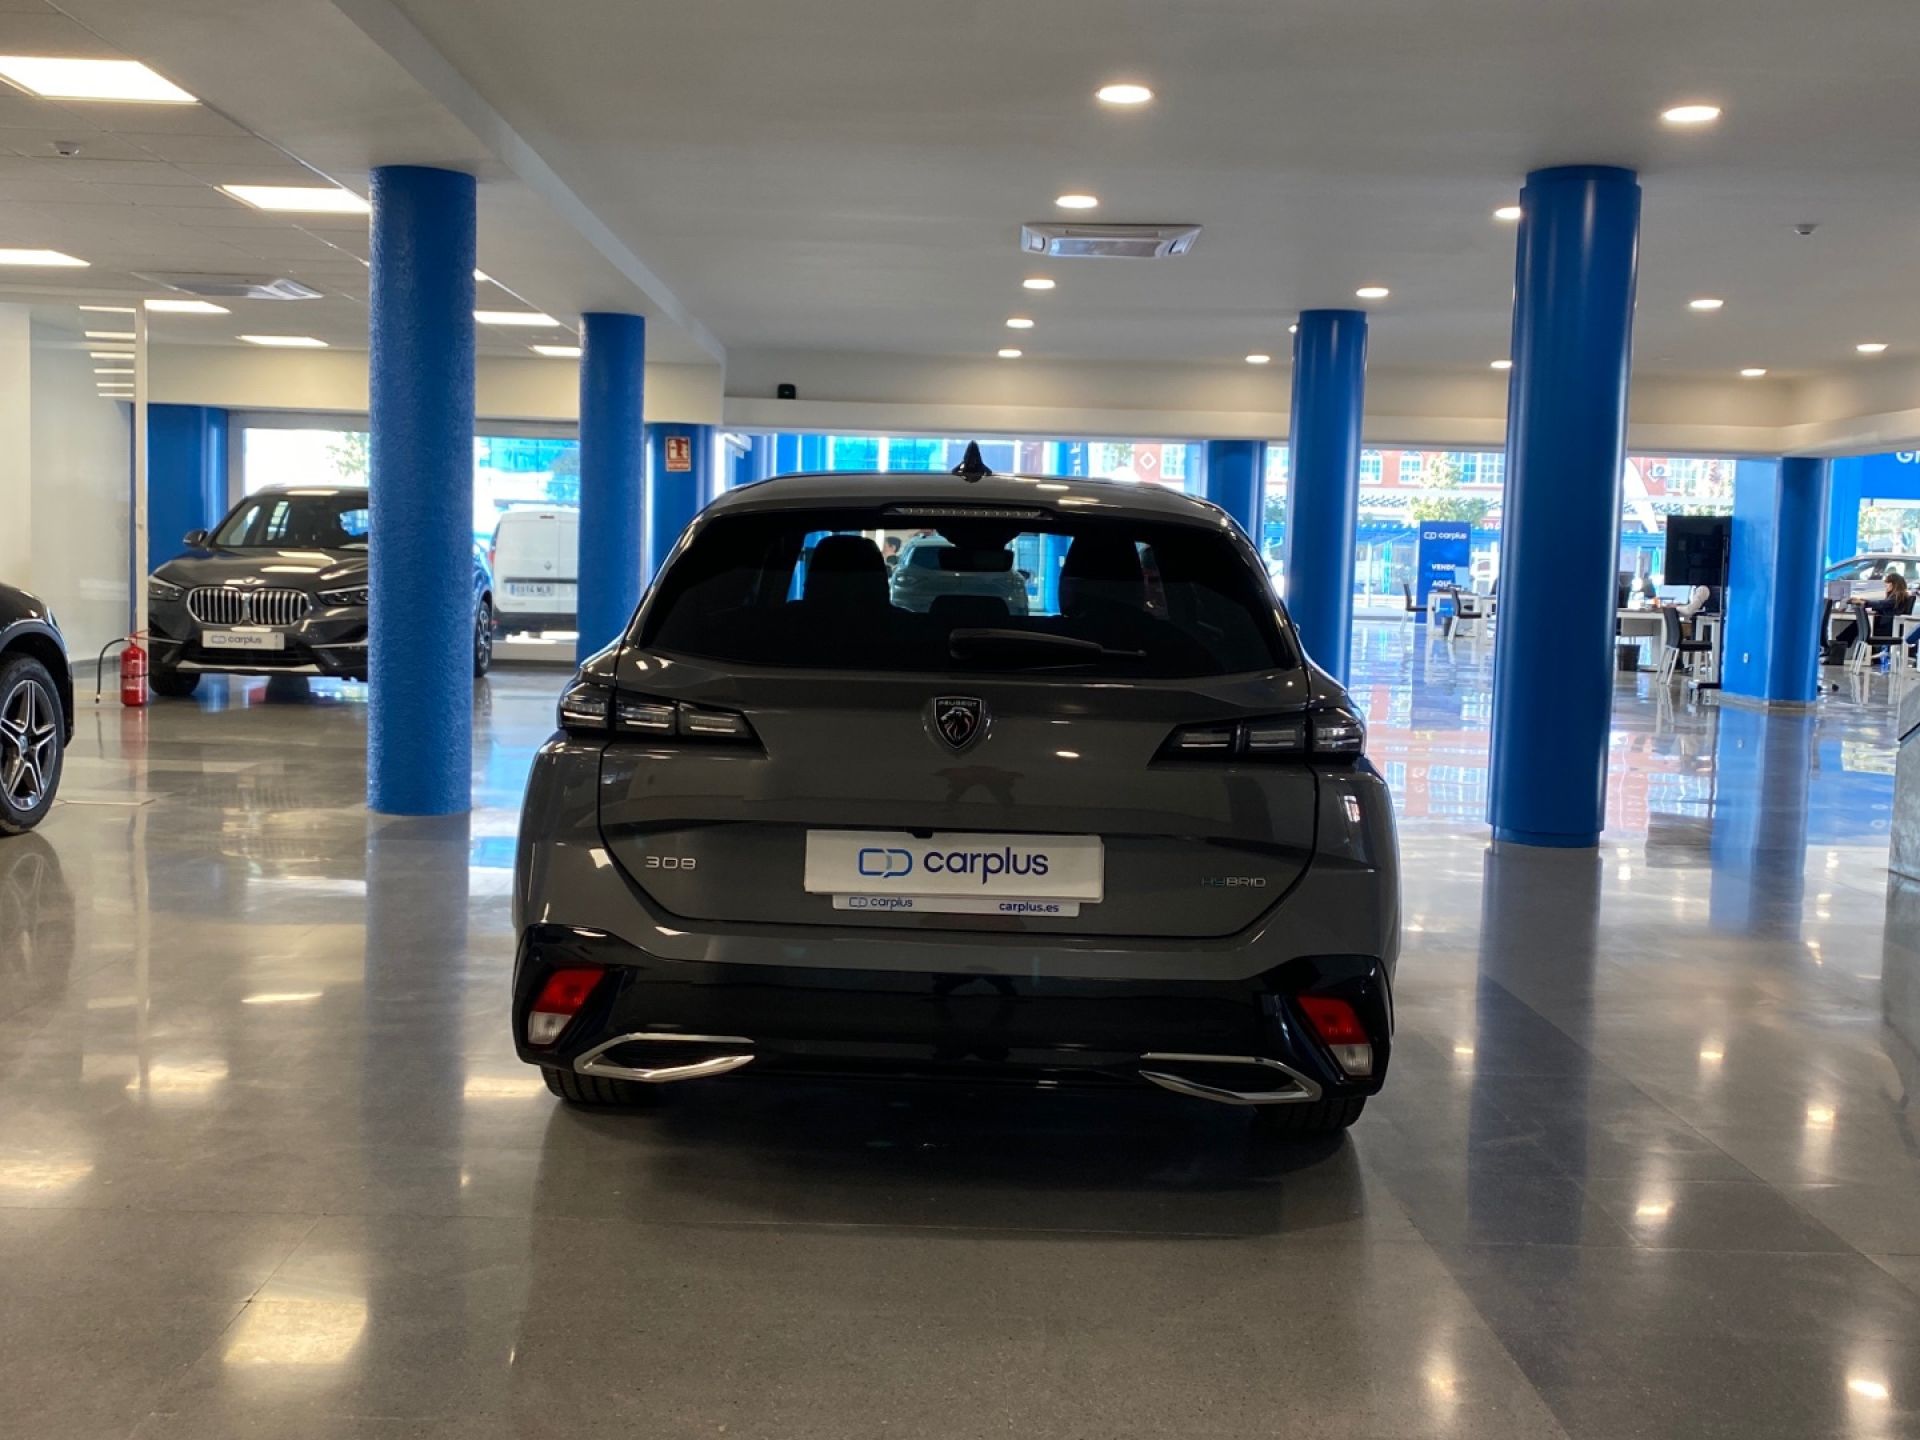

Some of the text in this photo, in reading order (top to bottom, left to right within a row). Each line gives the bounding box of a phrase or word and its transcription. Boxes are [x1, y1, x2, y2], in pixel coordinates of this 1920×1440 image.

[1438, 531, 1467, 541] carplus
[228, 635, 262, 645] carplus
[645, 855, 696, 869] 308
[923, 846, 1049, 884] carplus
[1201, 876, 1266, 887] HYBRID
[870, 896, 913, 910] carplus
[998, 901, 1060, 914] carplus.es
